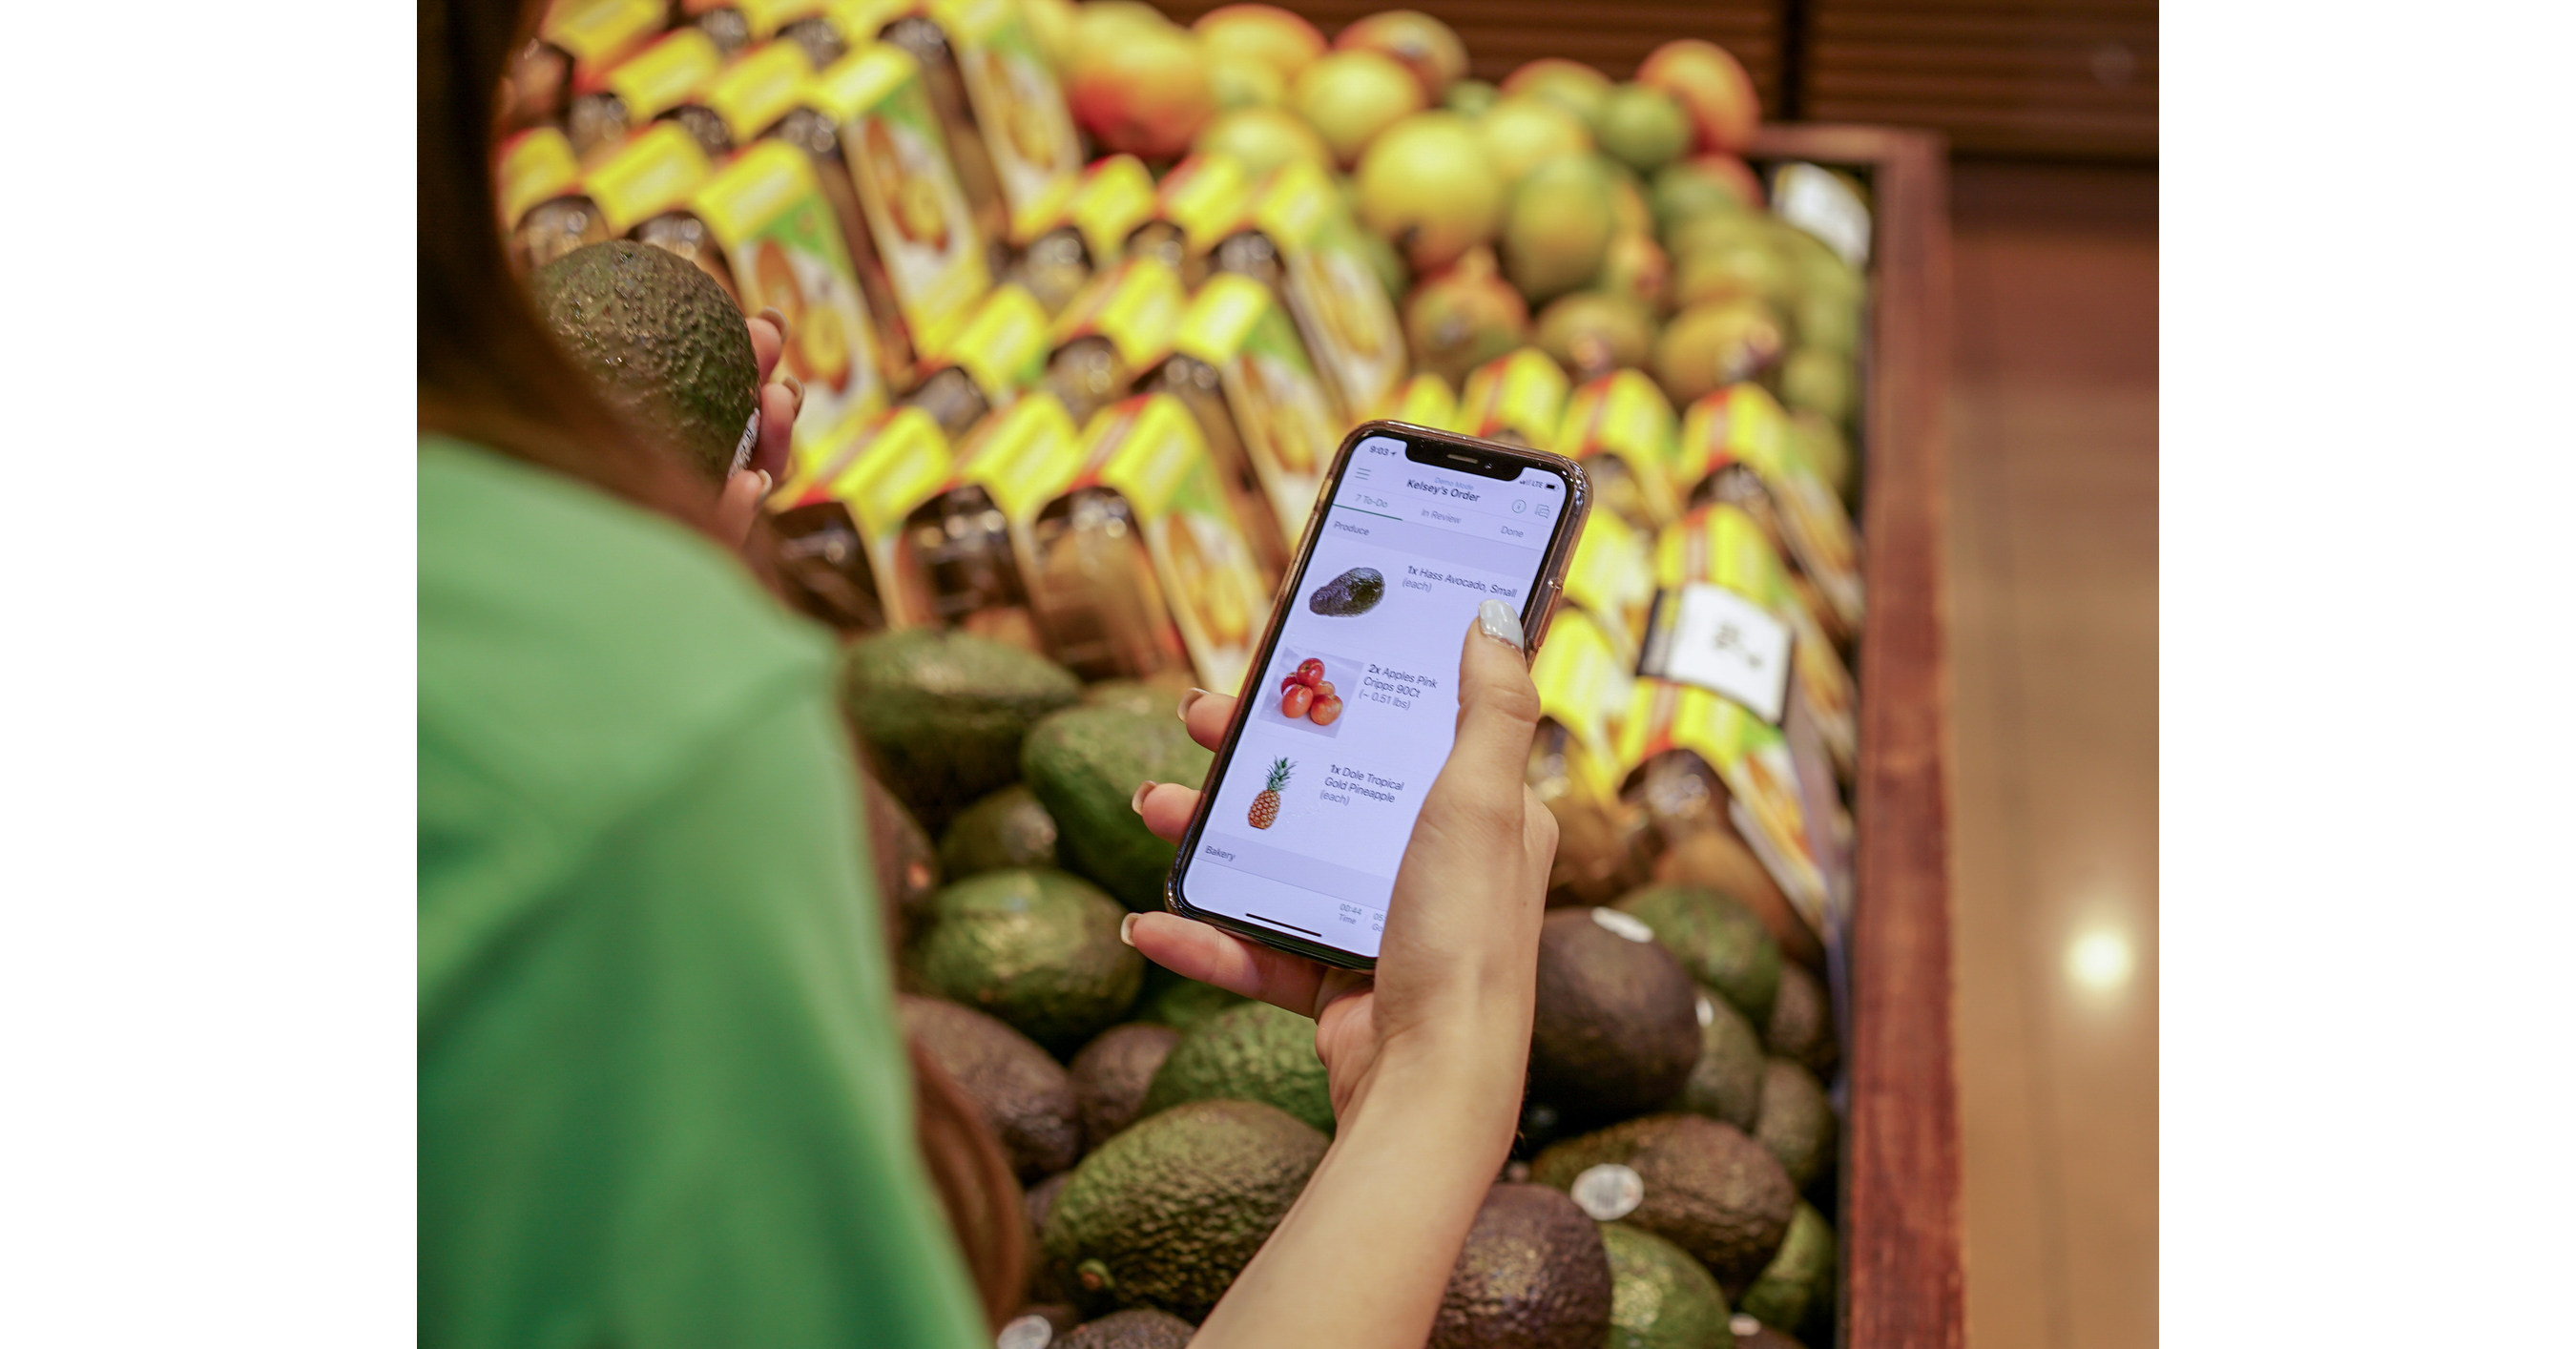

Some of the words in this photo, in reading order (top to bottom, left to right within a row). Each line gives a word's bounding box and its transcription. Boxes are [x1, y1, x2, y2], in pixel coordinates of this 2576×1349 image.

[1369, 445, 1389, 456] 9:03
[1406, 479, 1447, 497] Kelsey's
[1450, 488, 1481, 503] Order
[1531, 480, 1544, 488] LTE
[1355, 493, 1361, 502] 7
[1362, 495, 1388, 508] To-Do
[1422, 508, 1429, 518] In
[1430, 510, 1462, 524] Review
[1334, 521, 1370, 536] Produce
[1500, 526, 1524, 538] Done
[1402, 577, 1432, 593] (each)
[1407, 565, 1418, 576] 1x
[1419, 568, 1444, 582] Hass
[1444, 574, 1488, 593] Avocado,
[1490, 583, 1518, 598] Small
[1368, 664, 1381, 675] 2x
[1382, 667, 1415, 685] Apples
[1417, 674, 1439, 689] Pink
[1363, 676, 1396, 695] Cripps
[1397, 684, 1422, 698] 90Ct
[1371, 692, 1392, 705] 0.51
[1393, 697, 1412, 711] lbs)
[1330, 763, 1341, 776] 1x
[1342, 767, 1365, 781] Dole
[1366, 773, 1405, 791] Tropical
[1319, 790, 1351, 806] (each)
[1324, 777, 1347, 790] Gold
[1348, 782, 1396, 803] Pineapple
[1205, 845, 1236, 862] Bakery
[1339, 913, 1357, 924] Time
